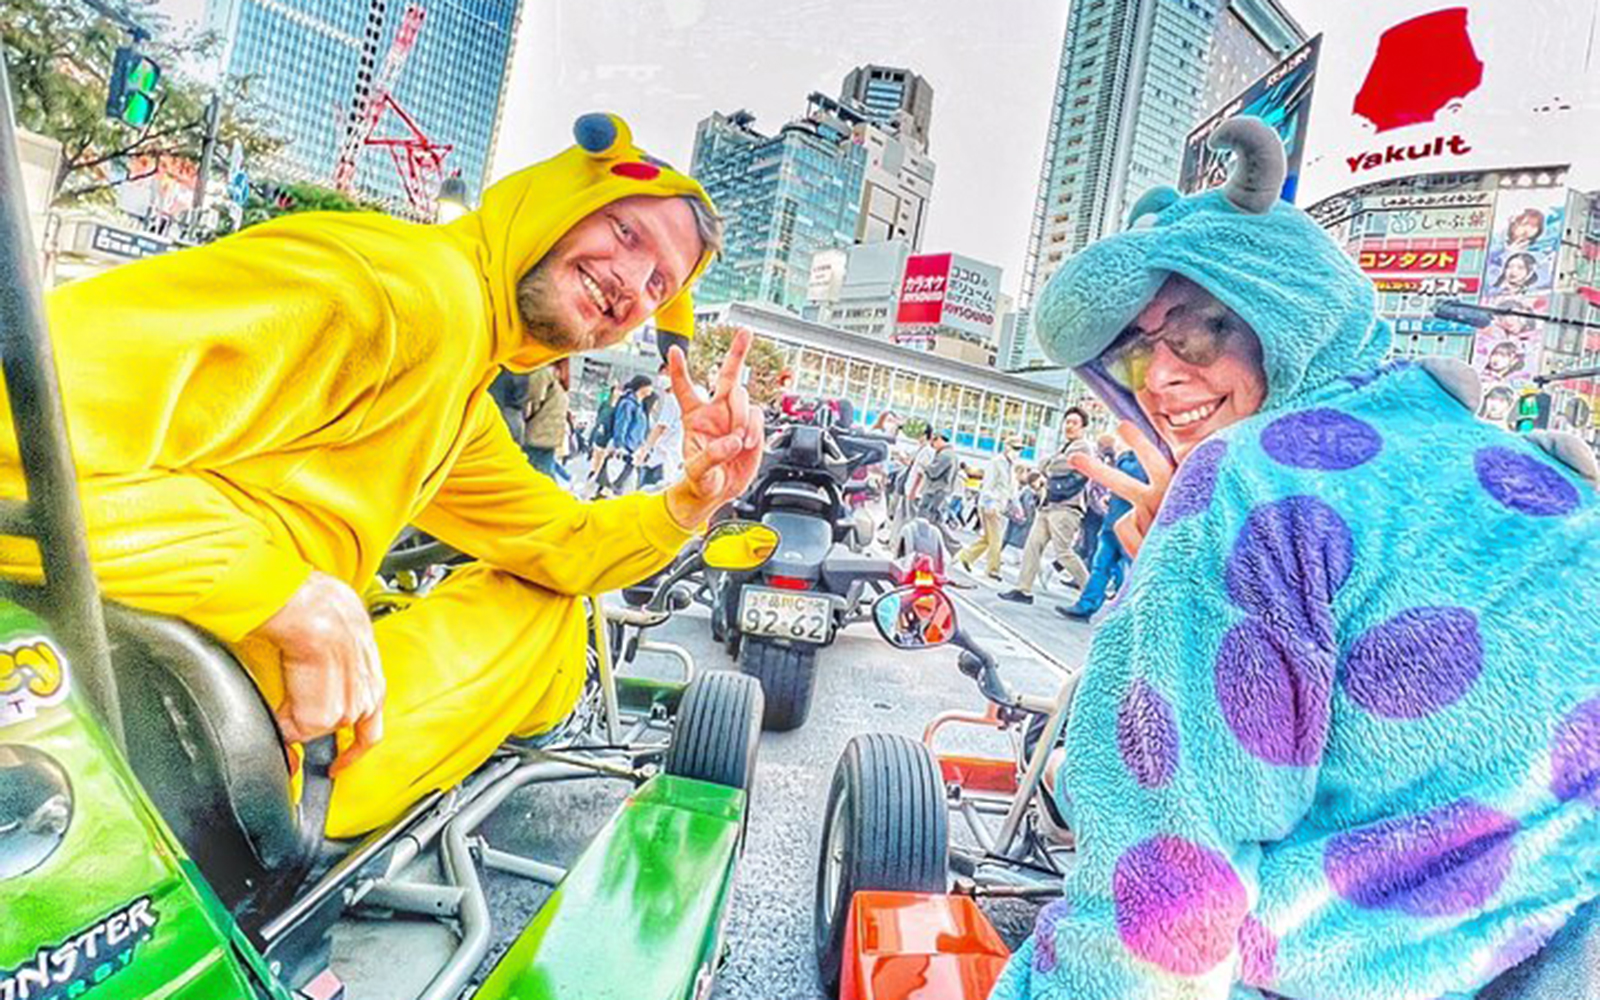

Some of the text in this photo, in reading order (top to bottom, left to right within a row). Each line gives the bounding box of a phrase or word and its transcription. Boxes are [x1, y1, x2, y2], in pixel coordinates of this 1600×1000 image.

[1346, 135, 1472, 172] Yakult
[1359, 251, 1454, 269] コンタクト
[904, 275, 945, 292] カラオケ
[1418, 277, 1468, 296] ガスト
